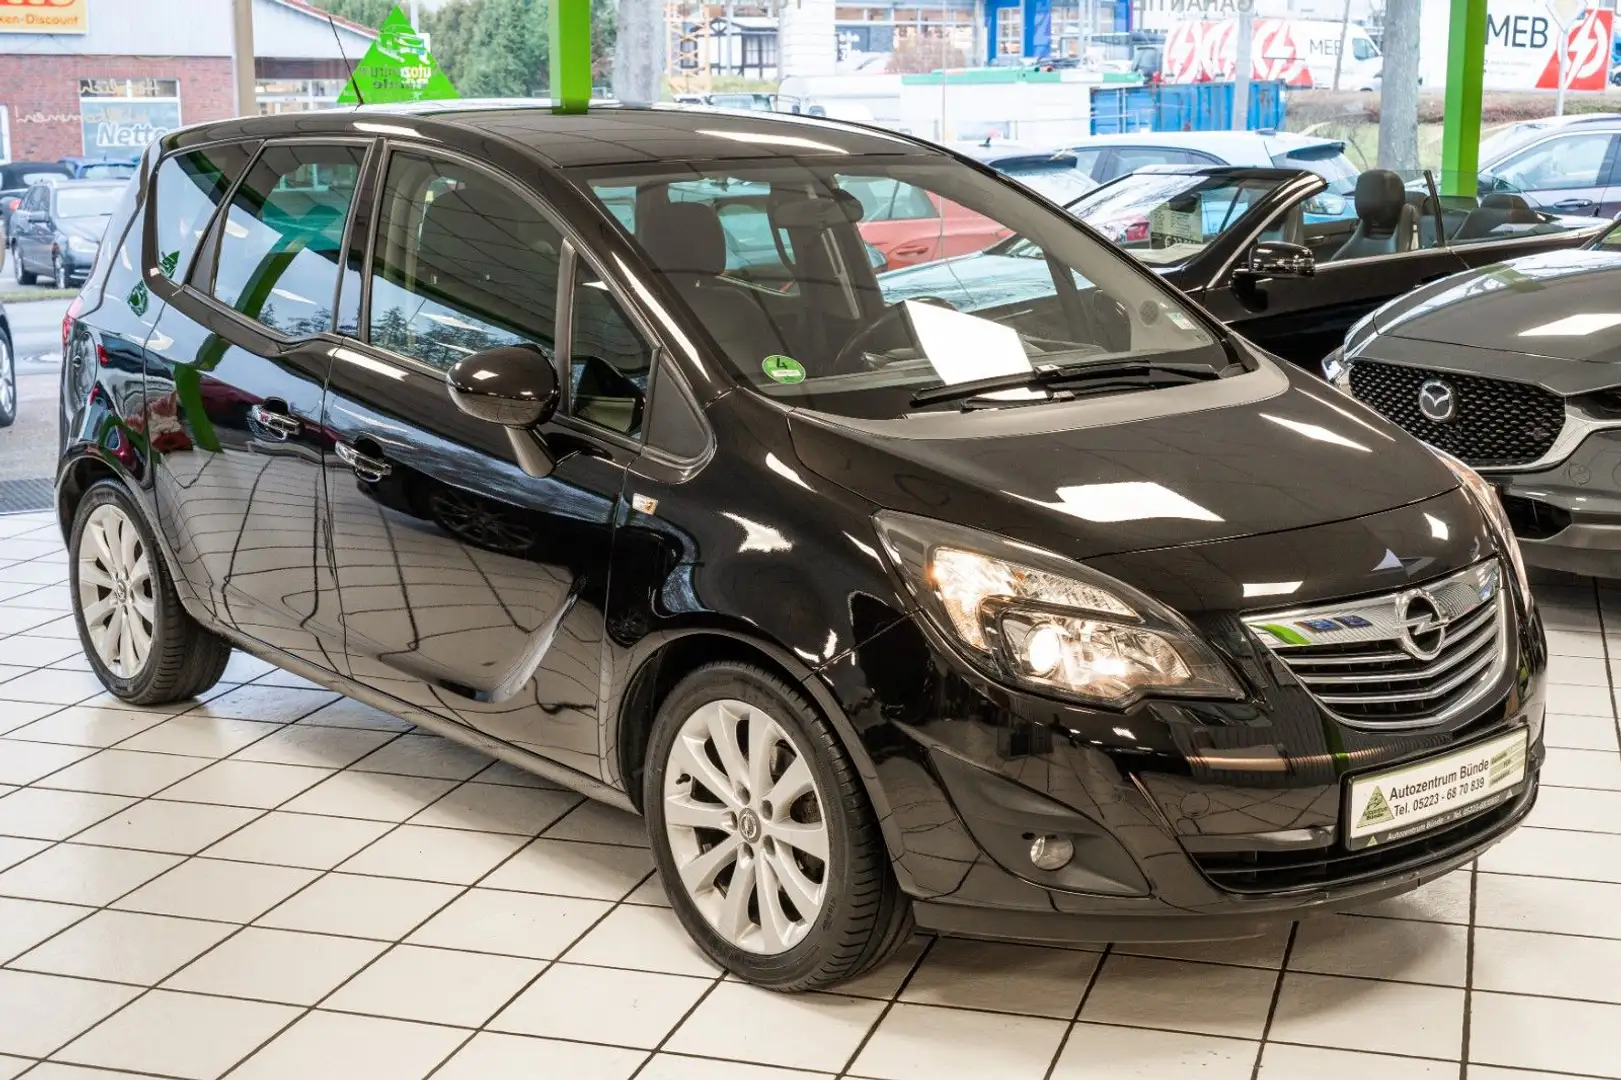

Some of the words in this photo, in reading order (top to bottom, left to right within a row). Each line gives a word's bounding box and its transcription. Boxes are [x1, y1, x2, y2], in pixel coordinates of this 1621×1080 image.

[1486, 13, 1549, 49] MEB
[1389, 771, 1457, 801] Autozentrum
[1459, 759, 1489, 780] Bünde
[1394, 804, 1411, 817] Tel.
[1413, 793, 1439, 812] 05223
[1446, 787, 1457, 800] 68
[1459, 782, 1469, 796] 70
[1470, 776, 1485, 792] 839
